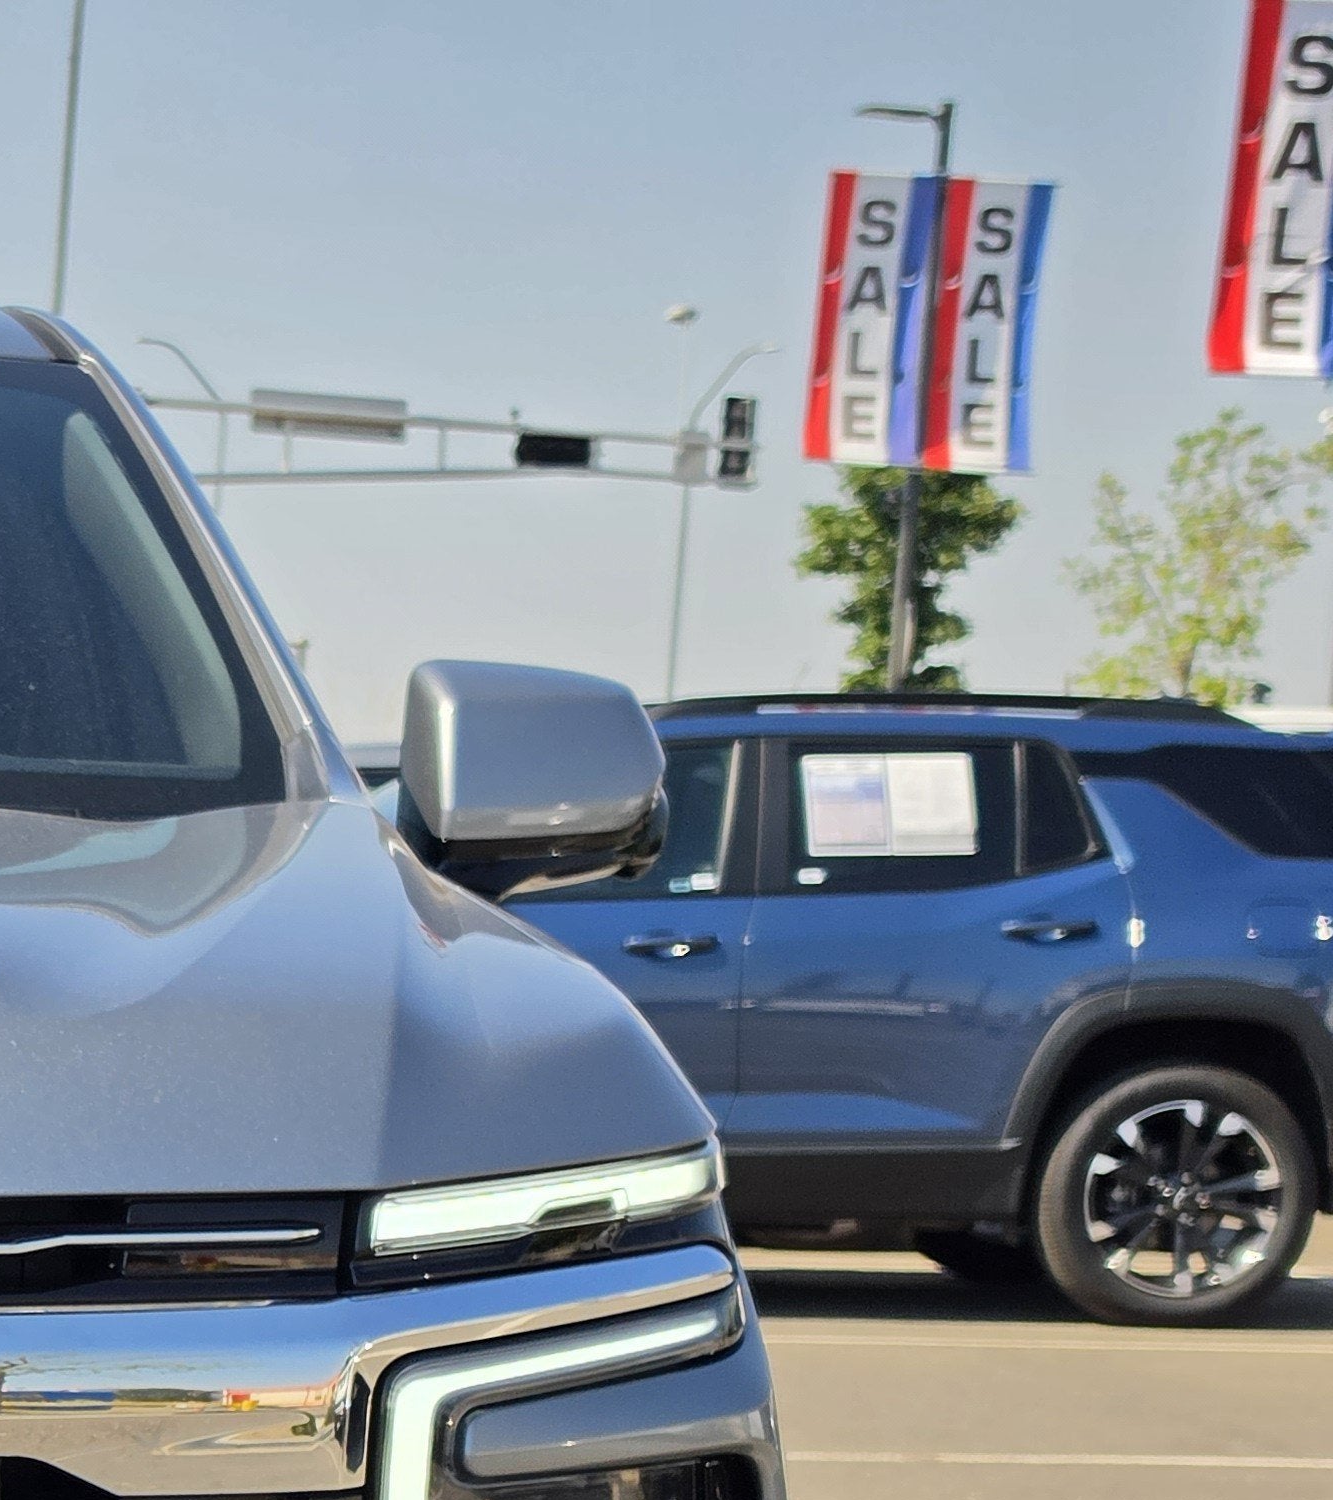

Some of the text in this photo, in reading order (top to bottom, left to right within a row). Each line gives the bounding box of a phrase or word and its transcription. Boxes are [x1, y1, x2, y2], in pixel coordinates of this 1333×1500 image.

[1259, 35, 1333, 349] SALE
[841, 199, 897, 442] SALE
[962, 206, 1015, 447] SALE
